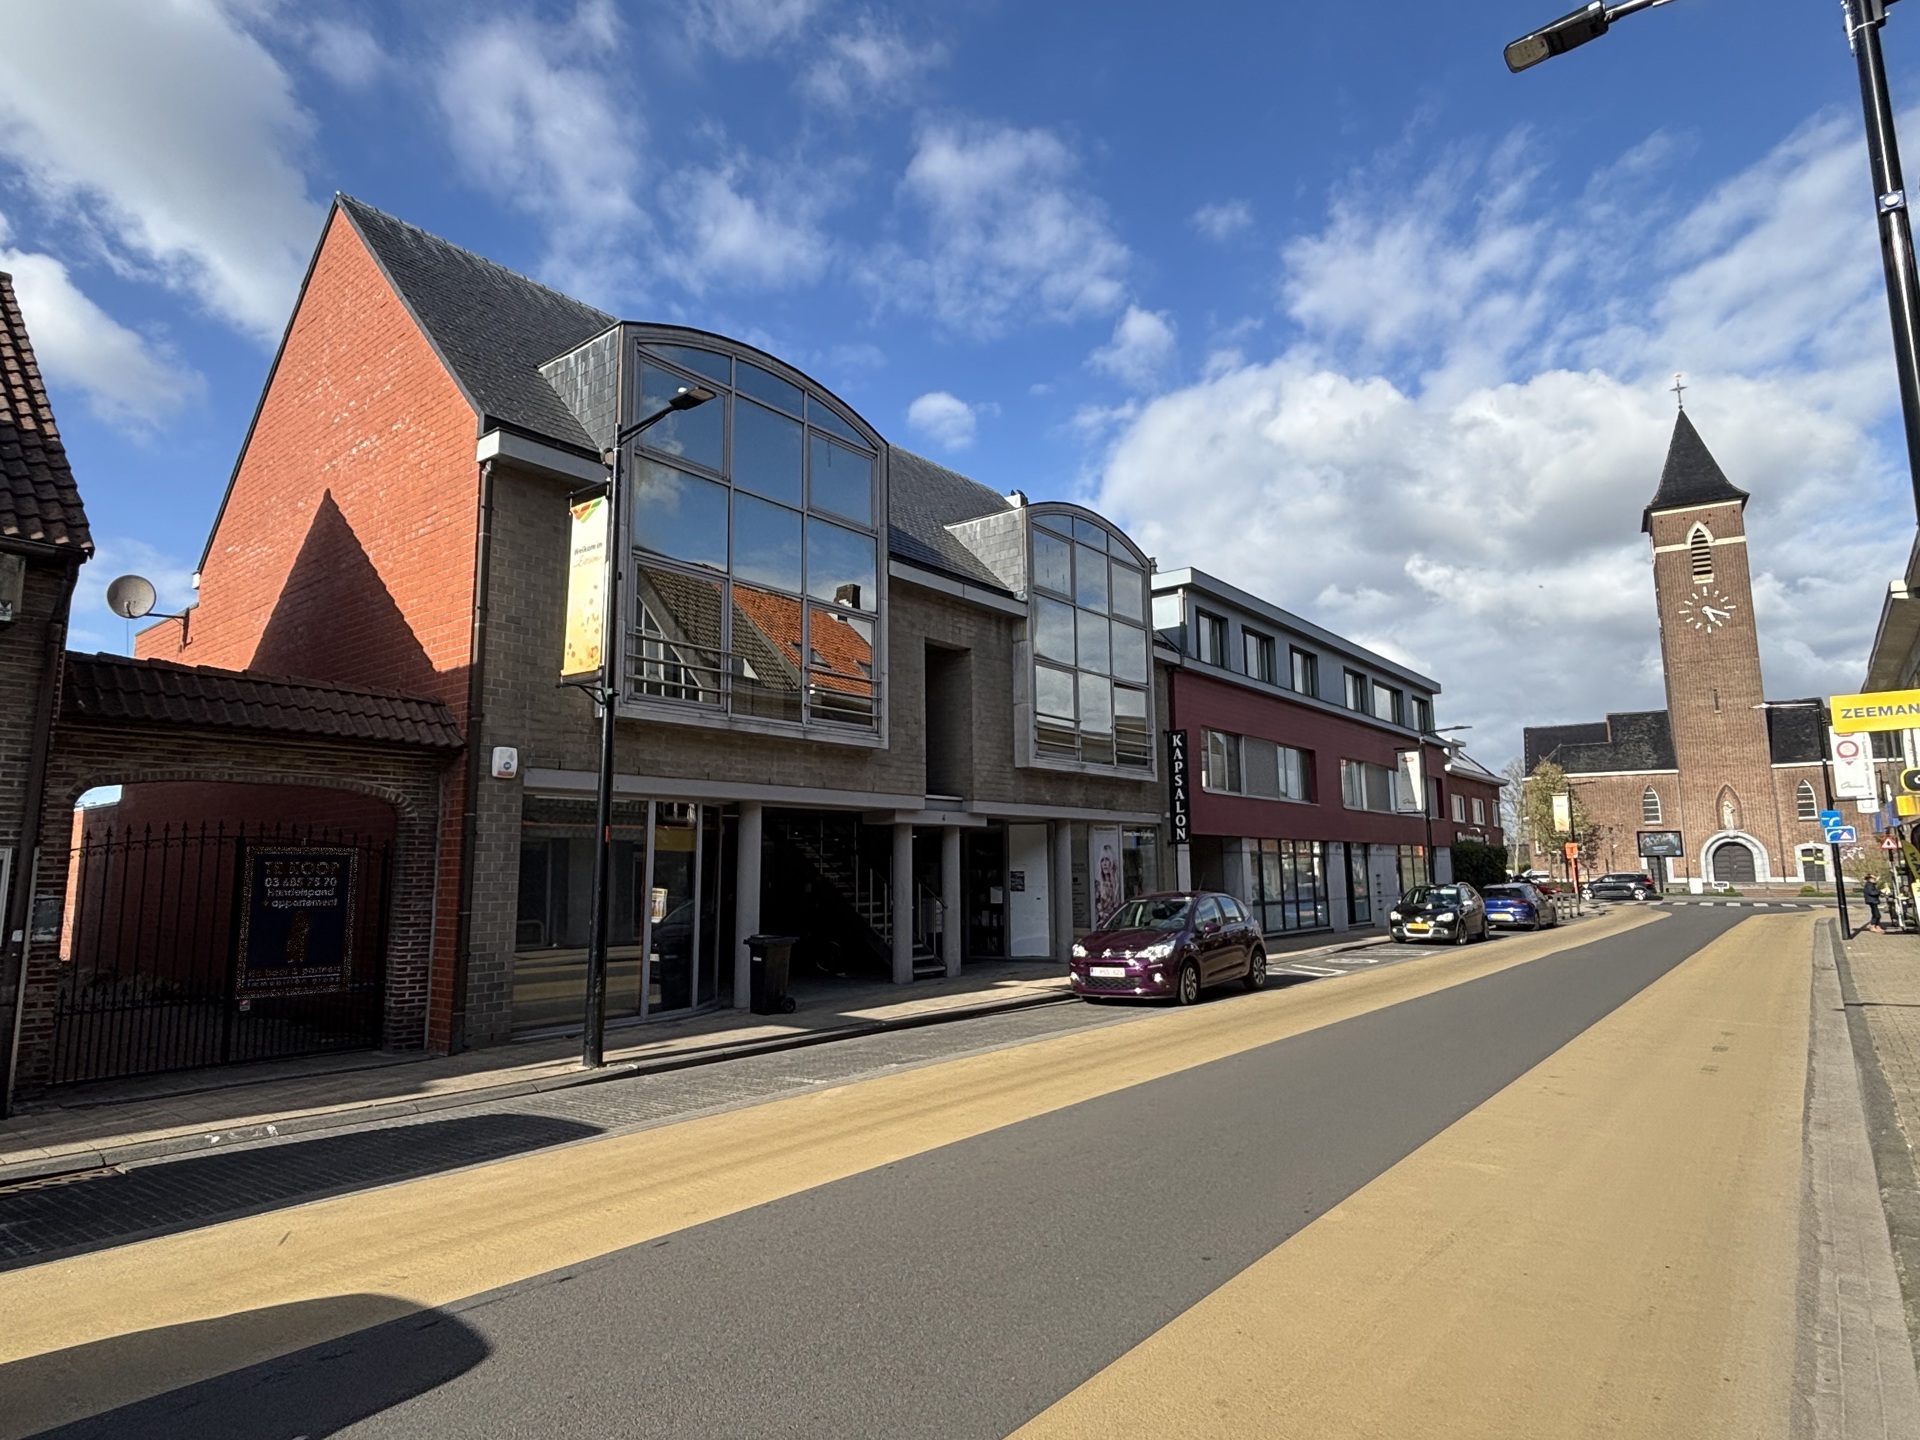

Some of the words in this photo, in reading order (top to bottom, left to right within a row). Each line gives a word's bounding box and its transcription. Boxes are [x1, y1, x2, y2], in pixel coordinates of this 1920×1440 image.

[574, 544, 596, 556] Welkom
[597, 541, 603, 549] in
[1840, 703, 1920, 719] ZEEMAN
[1172, 734, 1186, 841] KAPSALON
[264, 861, 283, 875] TE
[289, 861, 340, 875] KOOP
[264, 877, 280, 887] 03
[267, 887, 335, 898] Handelspand
[271, 898, 338, 909] appartement
